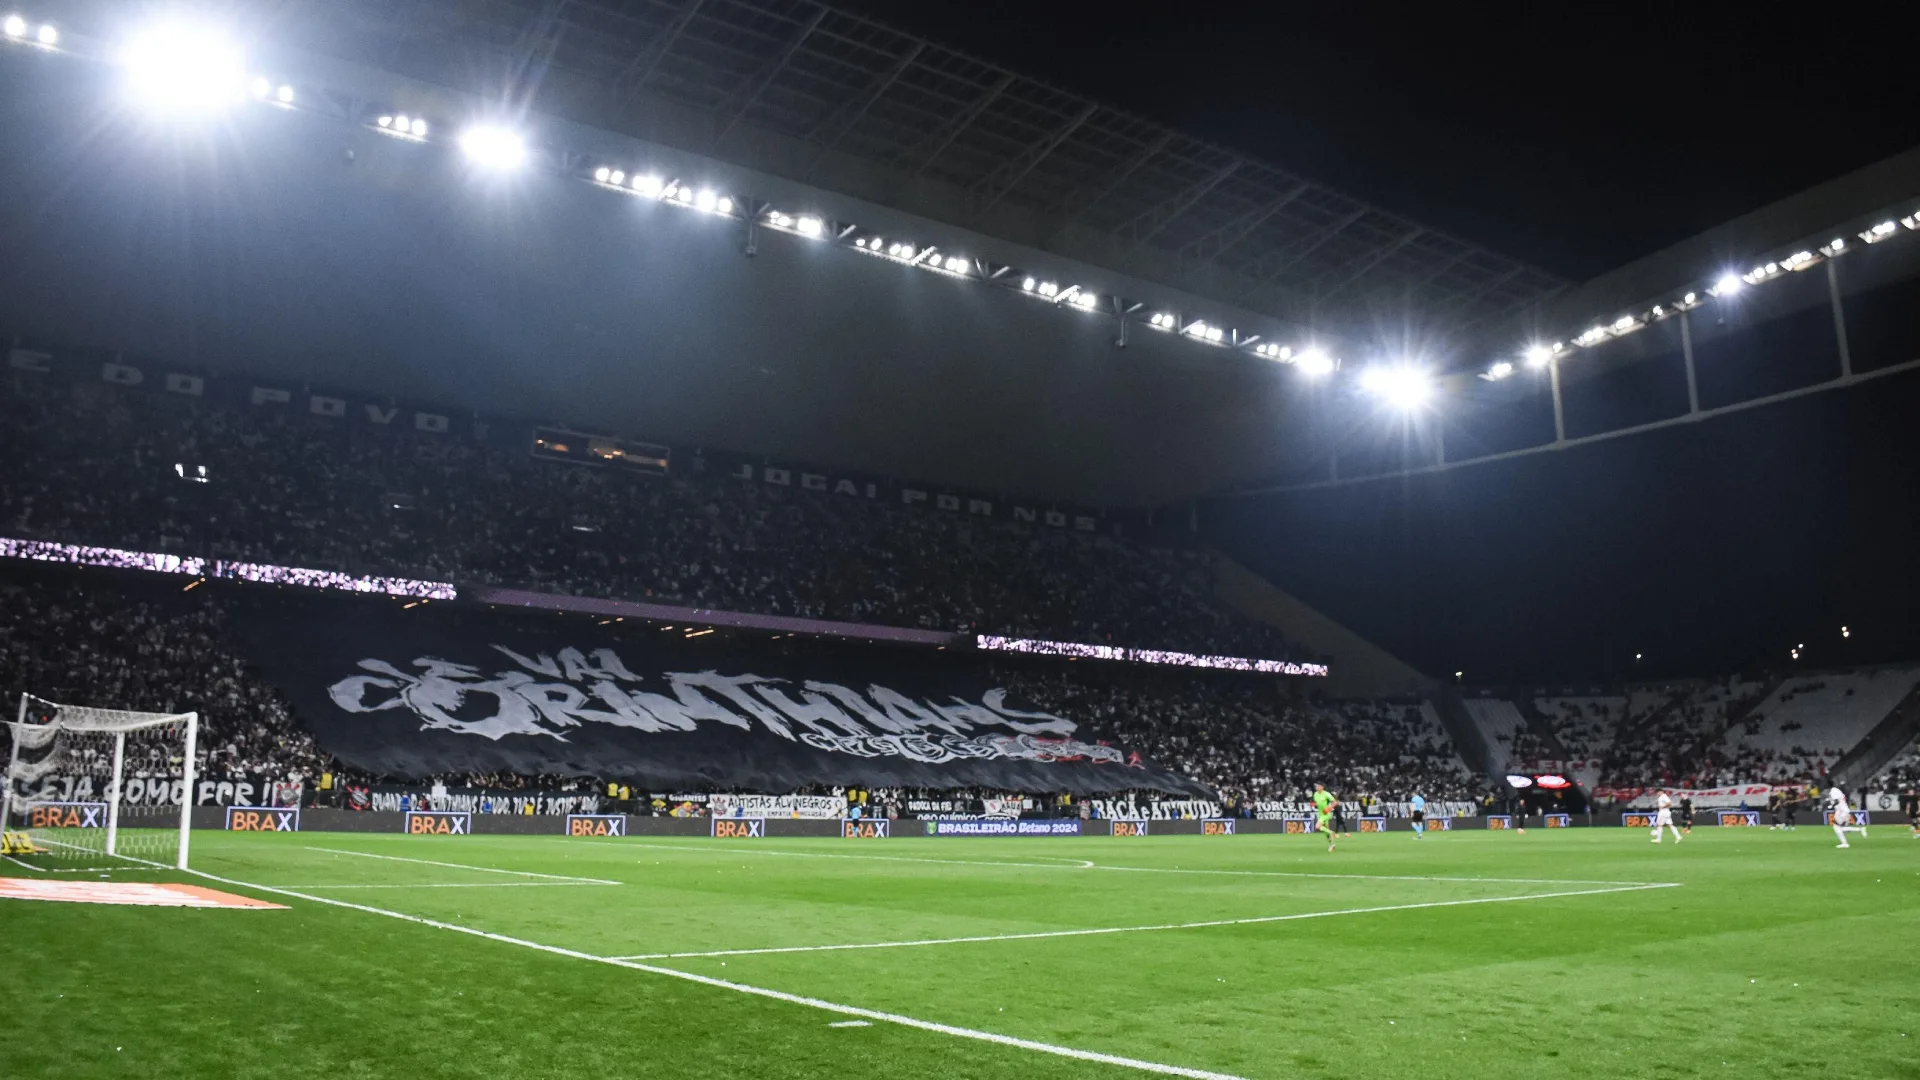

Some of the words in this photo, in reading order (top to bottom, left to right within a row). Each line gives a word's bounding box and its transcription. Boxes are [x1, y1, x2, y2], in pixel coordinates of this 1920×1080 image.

[102, 363, 204, 396] DO
[252, 387, 450, 432] POVO
[731, 463, 876, 499] JOGAI
[902, 489, 992, 516] POR
[487, 643, 644, 682] VAI
[728, 797, 772, 809] AUTISTAS
[774, 797, 831, 810] ALVINEGROS
[32, 807, 99, 828] BRAX
[232, 811, 293, 831] BRAX
[1489, 818, 1510, 830] BRAX
[1547, 817, 1567, 828] BRAX
[1626, 816, 1658, 827] BRAX
[1722, 814, 1757, 826] BRAX
[1829, 813, 1867, 825] BAX
[411, 816, 465, 835] BRAX
[572, 819, 620, 836] BRAX
[716, 821, 760, 837] BRAX
[938, 821, 1017, 833] BRASILEIRÃO
[1018, 823, 1051, 834] Betano
[1052, 824, 1078, 833] 2024
[1114, 823, 1145, 836] BRAX
[1204, 822, 1232, 835] BRAX
[1286, 821, 1311, 834] BRAX
[1361, 820, 1384, 832] BRAX
[1428, 820, 1450, 832] BRAX
